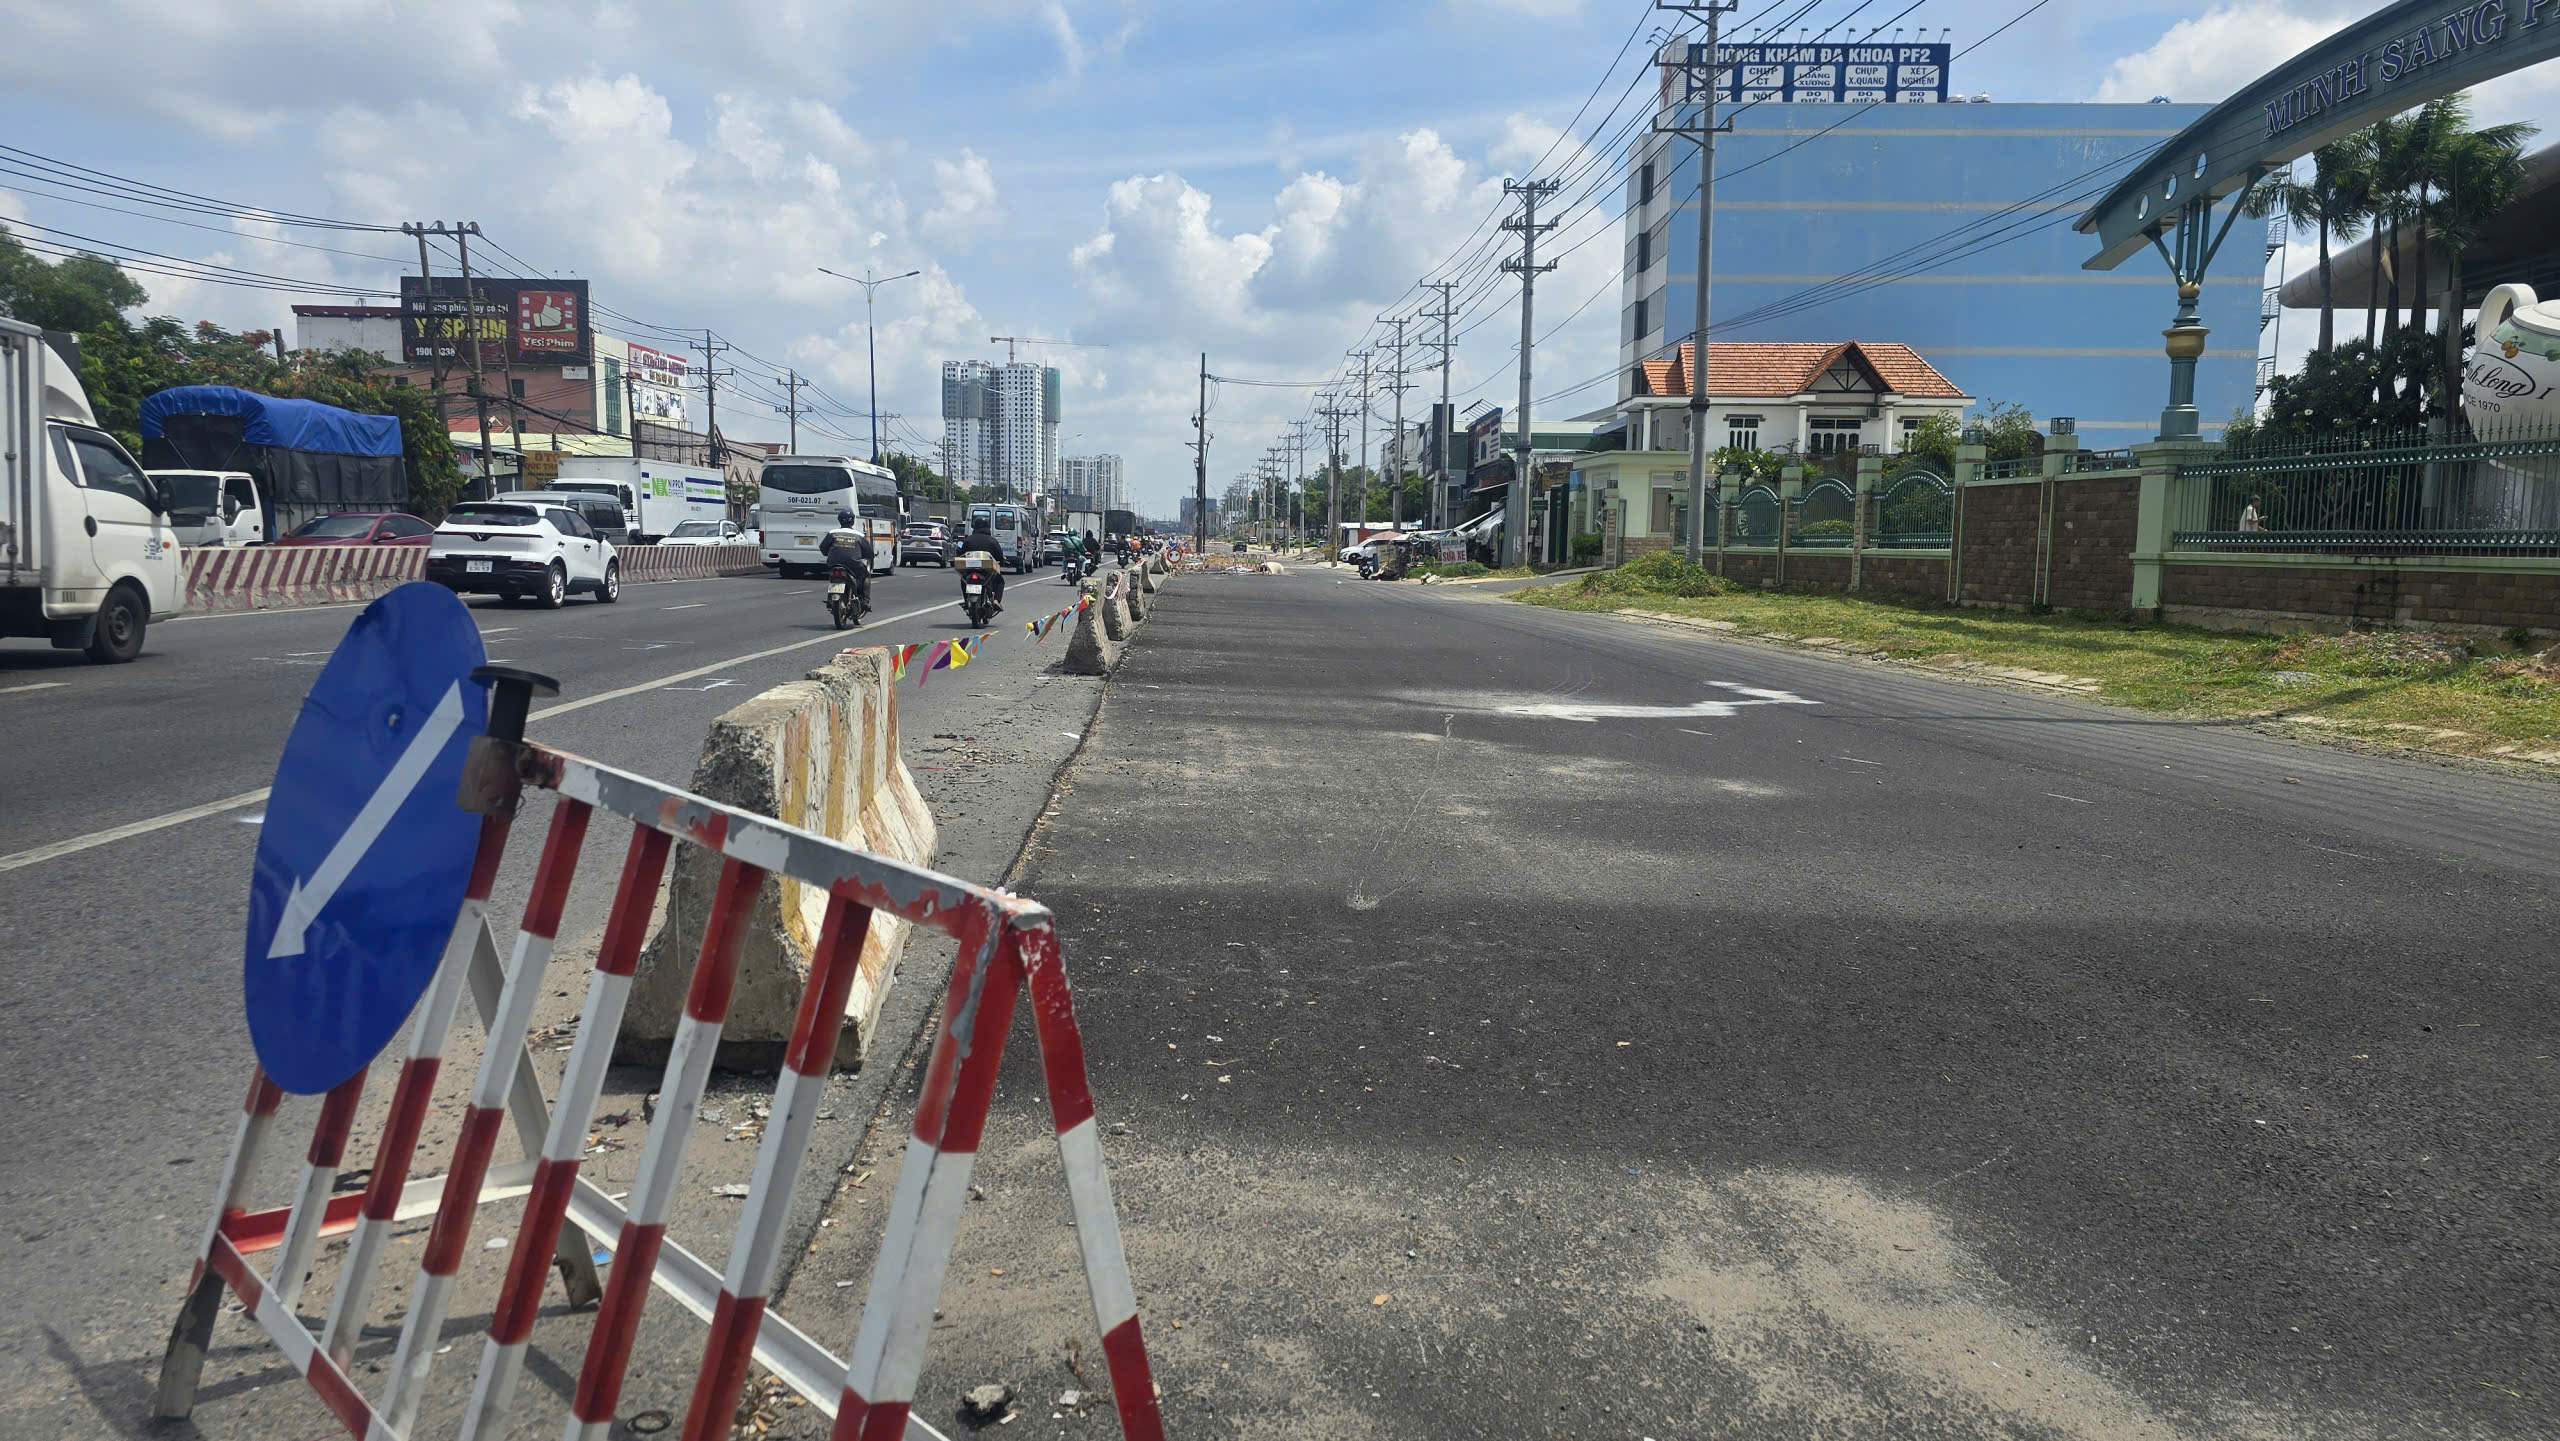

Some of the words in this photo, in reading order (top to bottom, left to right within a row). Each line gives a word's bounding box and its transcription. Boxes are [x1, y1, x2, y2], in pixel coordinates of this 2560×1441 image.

[1765, 45, 1815, 62] KHÁM
[1820, 48, 1843, 62] ĐA
[1848, 48, 1894, 62] KHOA
[1899, 48, 1931, 62] PF2
[1855, 67, 1878, 76] CHỤP
[2264, 53, 2368, 139] MINH
[2379, 0, 2506, 83] SANG
[2520, 0, 2560, 30] P
[1848, 77, 1884, 86] X.QUANG
[1699, 93, 1723, 101] SU
[412, 302, 426, 313] Nội
[2478, 399, 2501, 413] 1970
[787, 496, 821, 504] 50F-021.07
